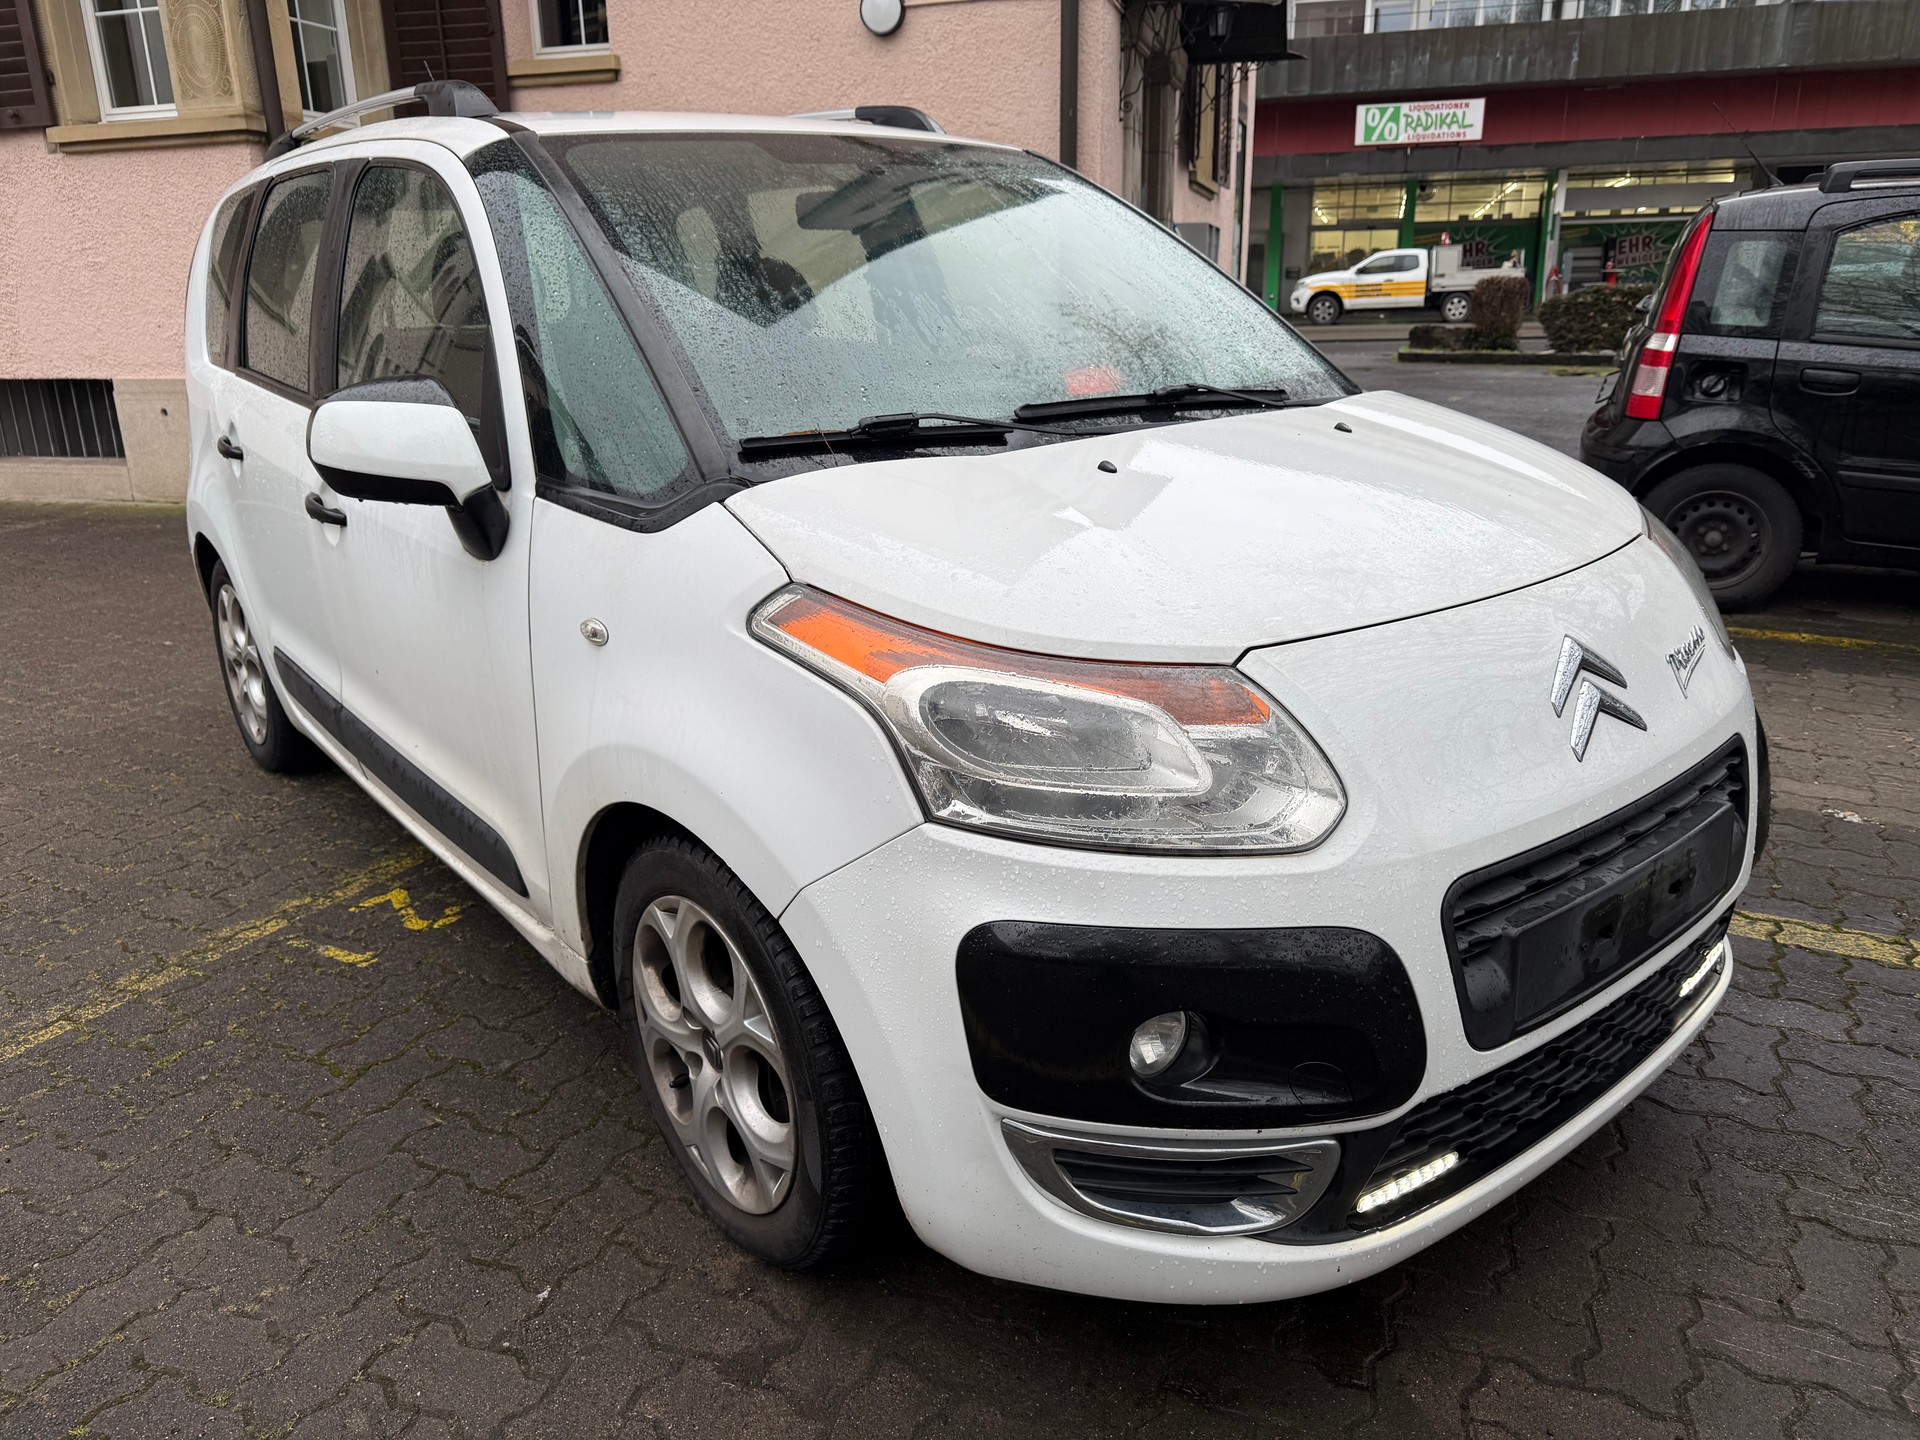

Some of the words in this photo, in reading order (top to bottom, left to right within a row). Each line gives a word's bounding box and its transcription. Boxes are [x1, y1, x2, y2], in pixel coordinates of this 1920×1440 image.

[1408, 102, 1470, 112] LIQUIDATIONEN
[1403, 110, 1474, 133] RADIKAL
[1407, 131, 1467, 141] LIQUIDATIONS
[1618, 235, 1653, 255] EHR
